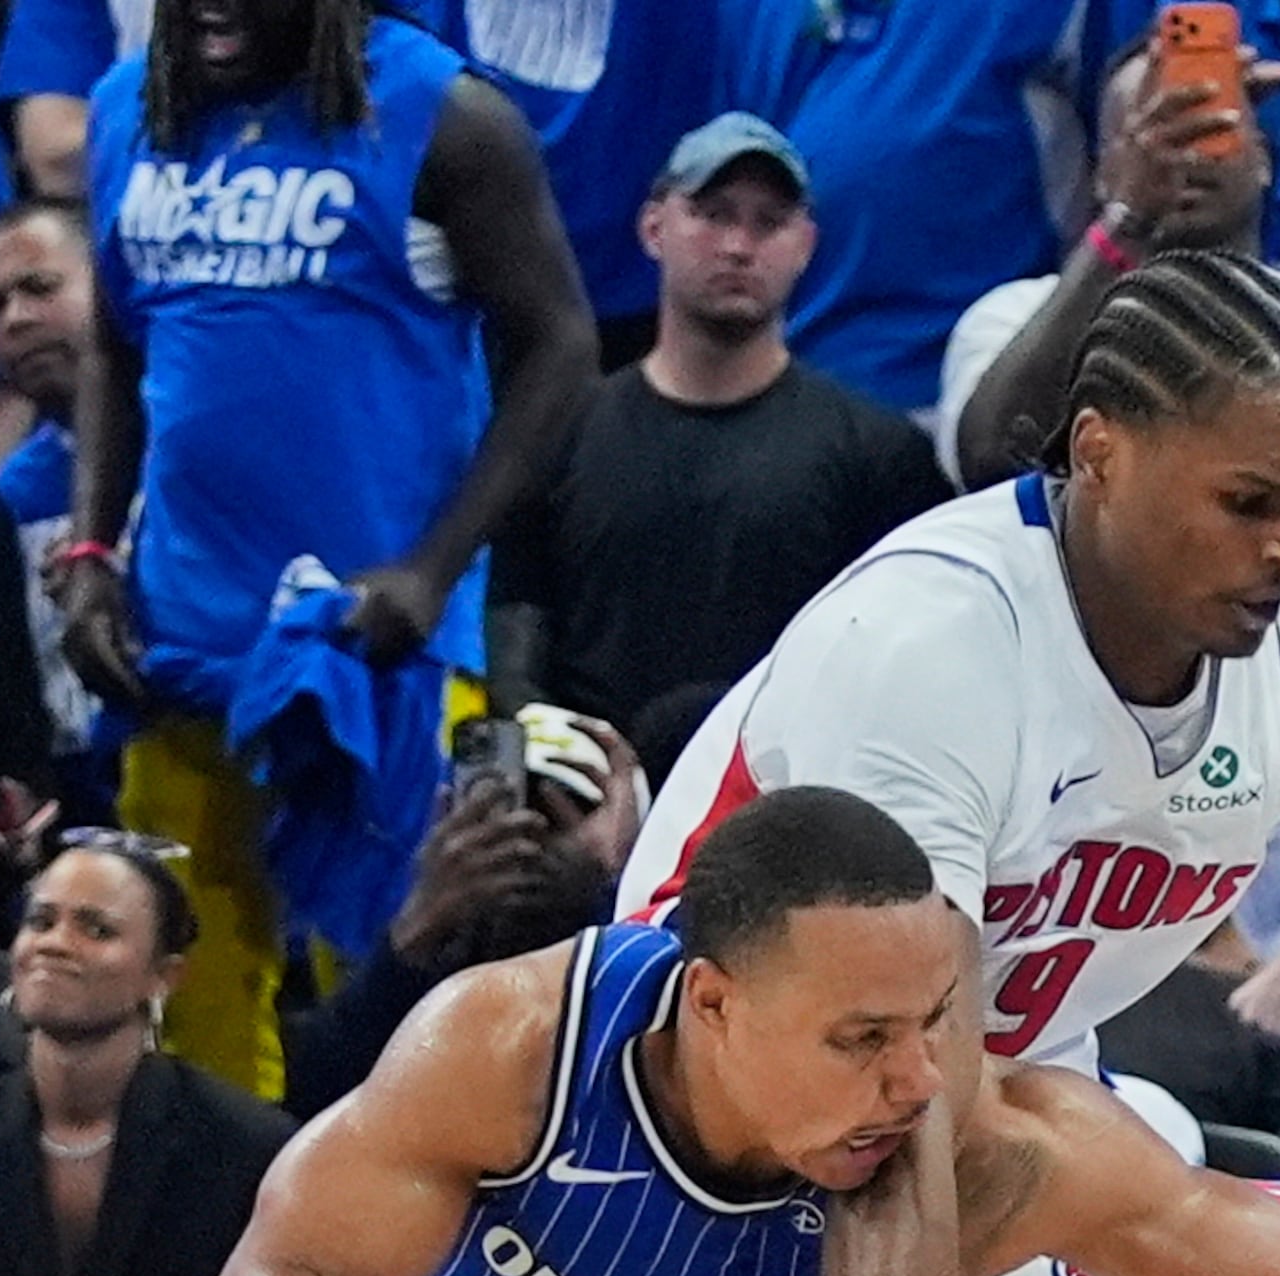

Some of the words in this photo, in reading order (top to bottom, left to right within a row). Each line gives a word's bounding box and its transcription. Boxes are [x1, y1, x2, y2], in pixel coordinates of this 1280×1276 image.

[1169, 785, 1262, 813] StockX
[983, 840, 1258, 948] PISTONS
[984, 938, 1096, 1057] 9
